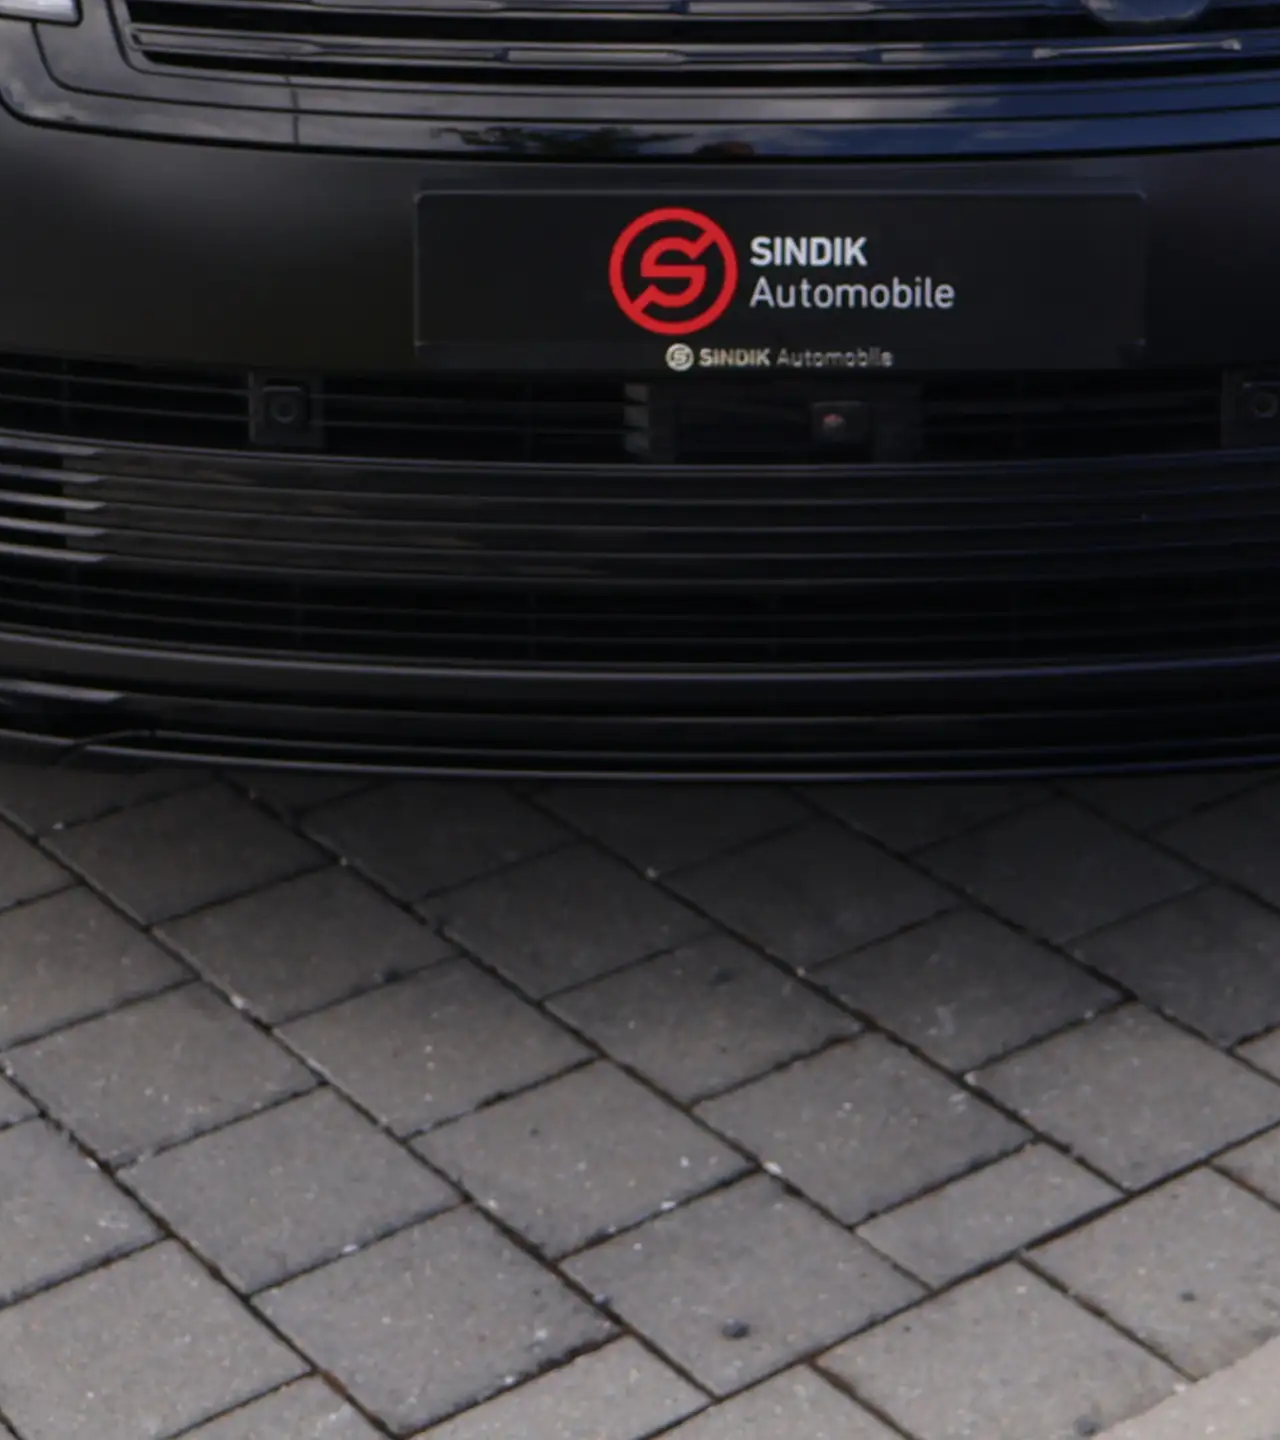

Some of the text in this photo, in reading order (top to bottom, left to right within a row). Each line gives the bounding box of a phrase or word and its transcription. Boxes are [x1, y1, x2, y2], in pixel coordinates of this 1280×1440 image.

[749, 235, 868, 267] SINDIK
[749, 275, 955, 309] Automobile
[699, 347, 771, 368] SINDIK
